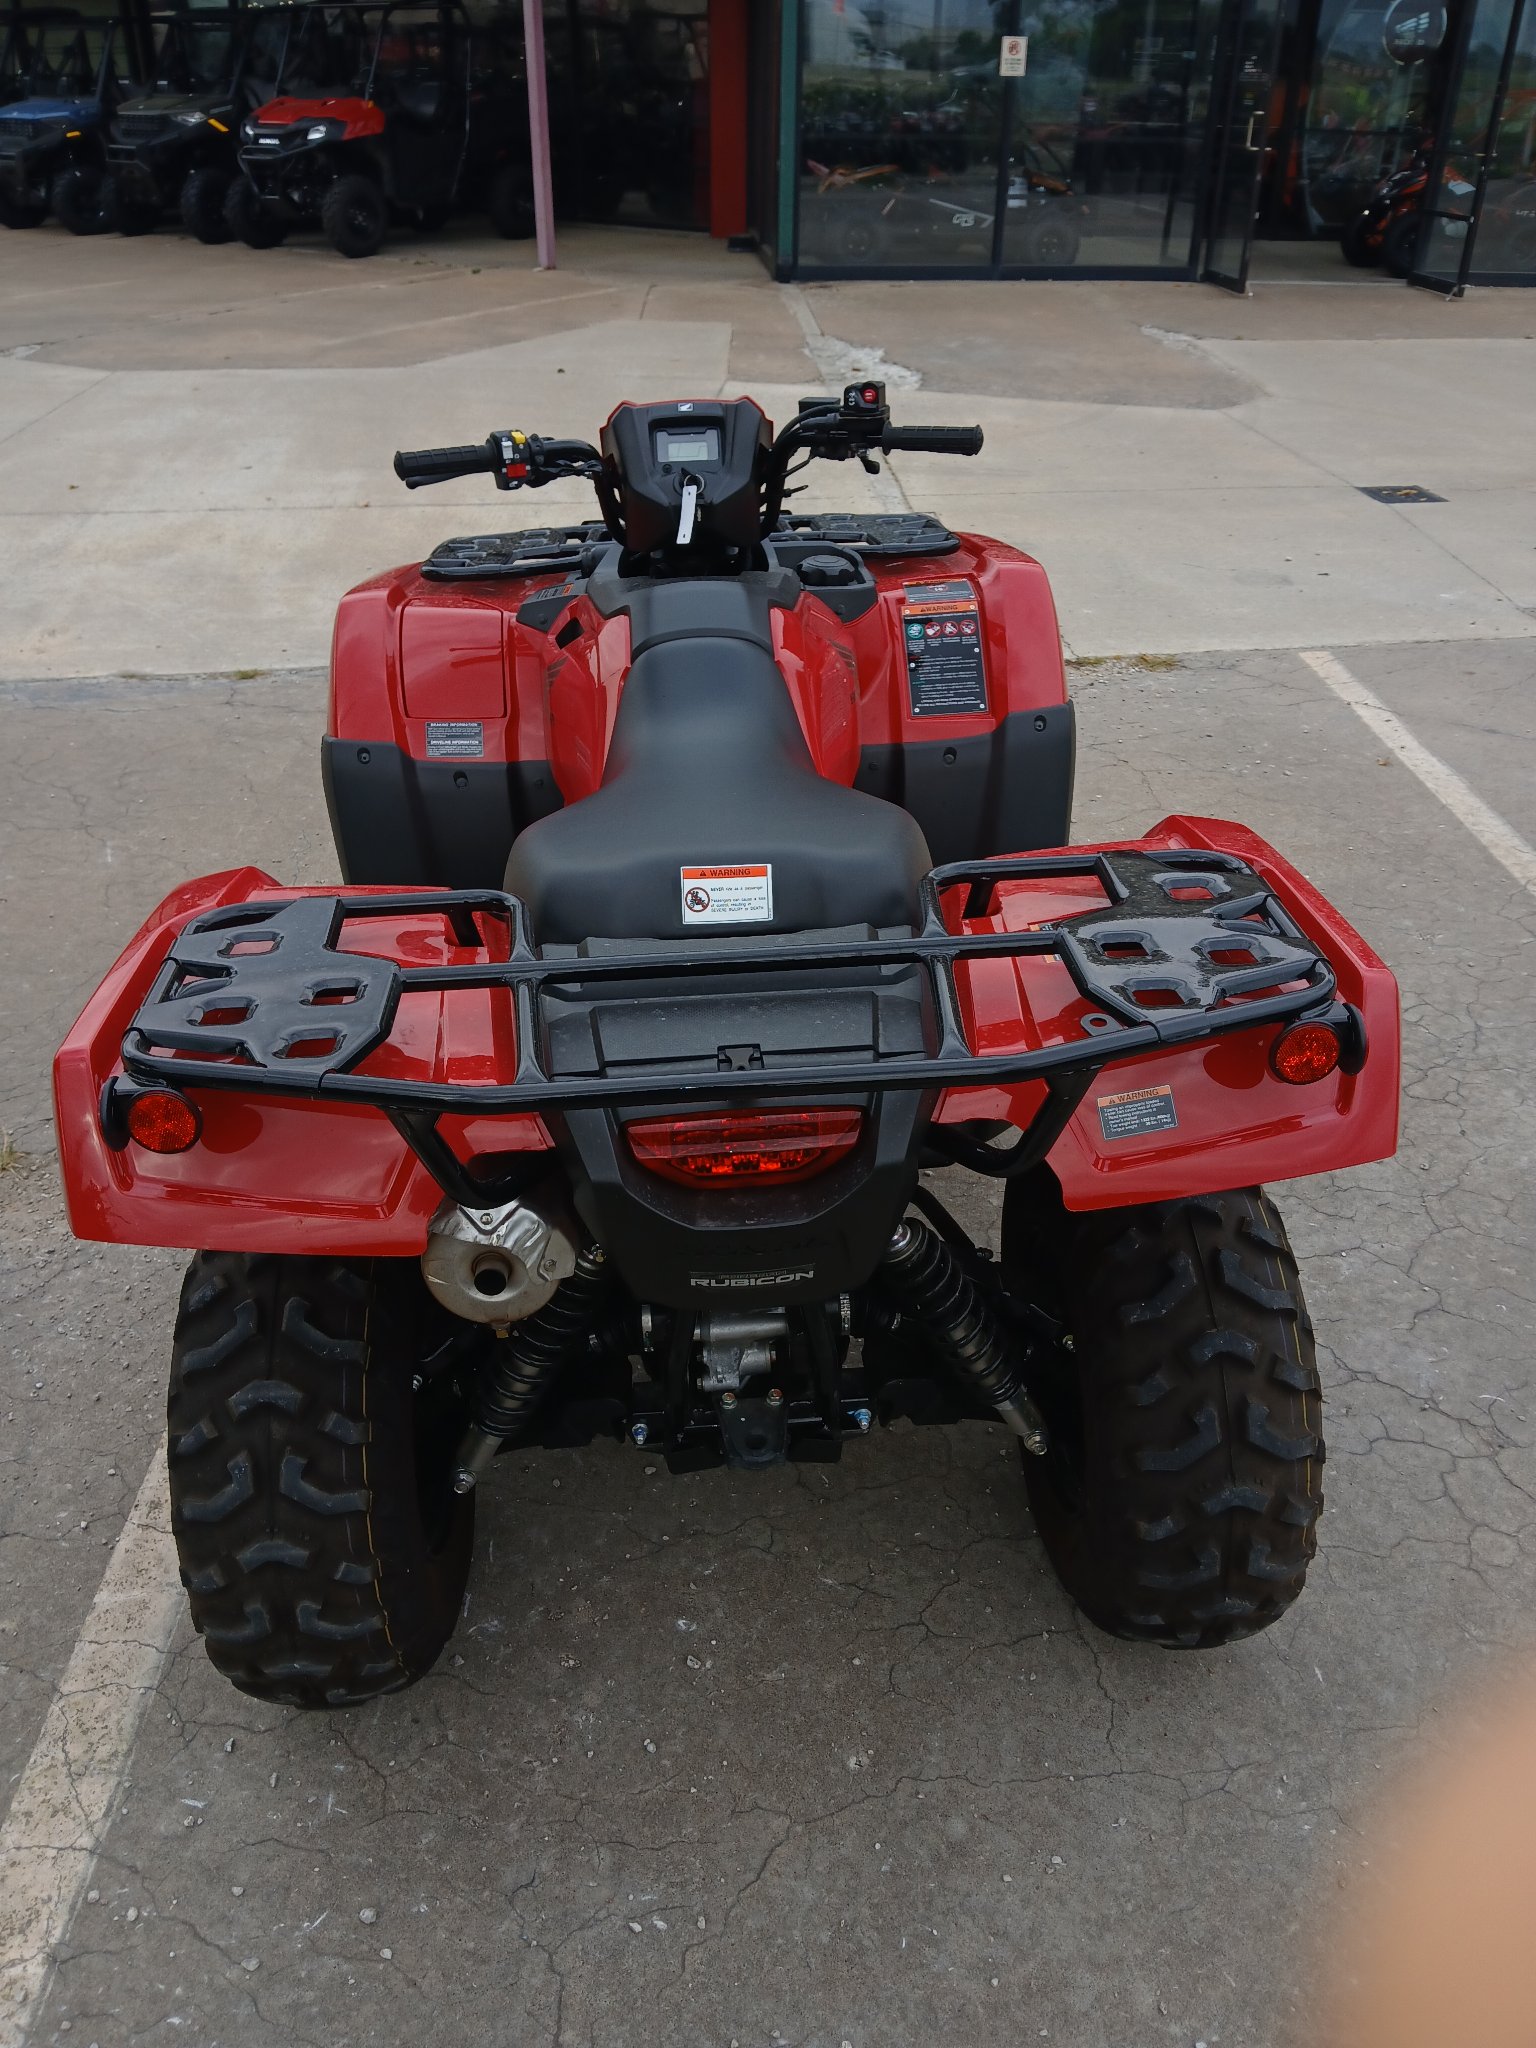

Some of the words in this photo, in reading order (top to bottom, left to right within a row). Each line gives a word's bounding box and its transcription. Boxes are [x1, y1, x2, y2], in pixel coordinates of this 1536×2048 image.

[925, 604, 958, 612] WARNING
[710, 869, 750, 877] WARNING
[1117, 1089, 1159, 1101] WARNING
[690, 1270, 814, 1287] RUBICON
